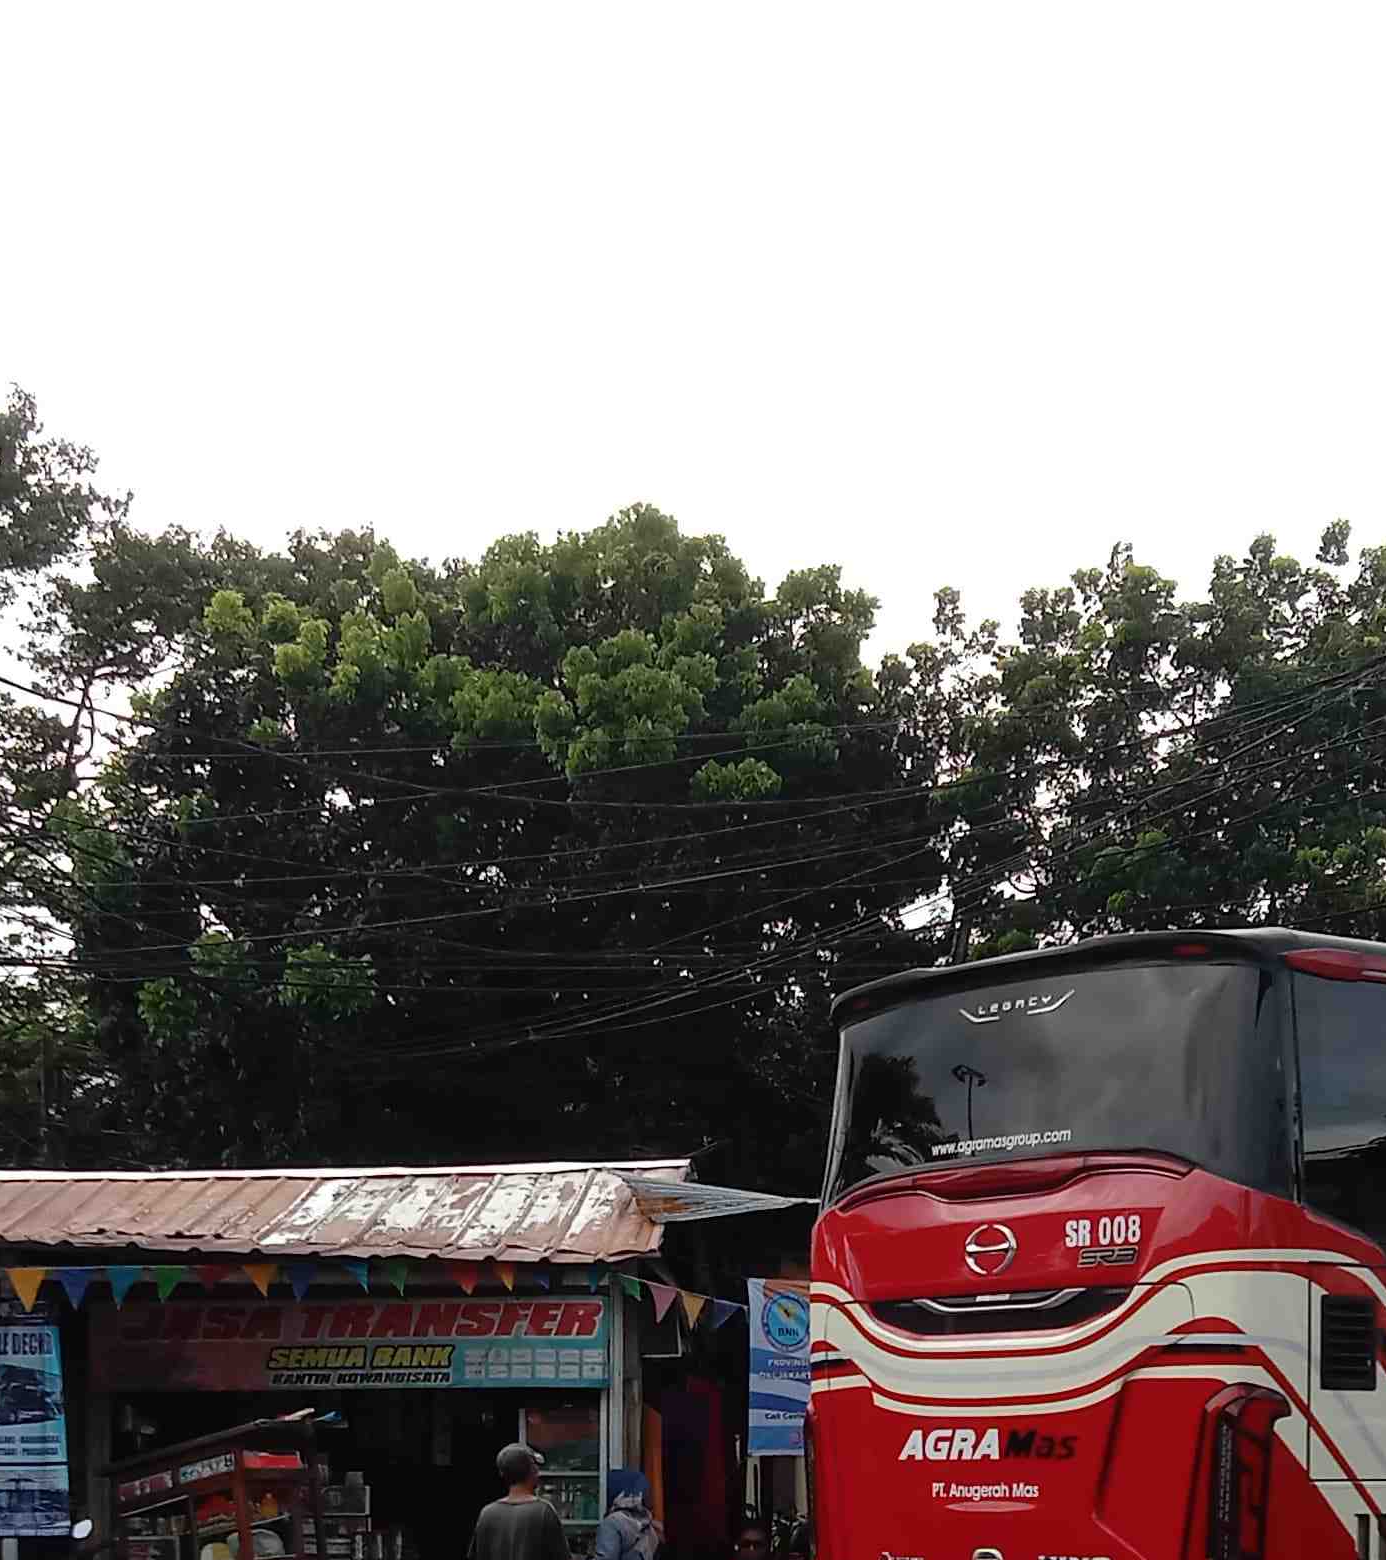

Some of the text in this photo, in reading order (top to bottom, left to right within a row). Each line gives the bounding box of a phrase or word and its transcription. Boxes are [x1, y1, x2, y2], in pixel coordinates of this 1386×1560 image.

[931, 1129, 1072, 1156] www.agramasgroup.com
[1065, 1215, 1141, 1247] SR 008
[296, 1300, 603, 1338] TRANSFER
[269, 1346, 367, 1369] SEMUA
[371, 1345, 454, 1368] BANK
[272, 1372, 332, 1385] KANTIN
[898, 1428, 1077, 1460] AGRA Mas
[932, 1483, 1039, 1501] PT. Anugerah Mas
